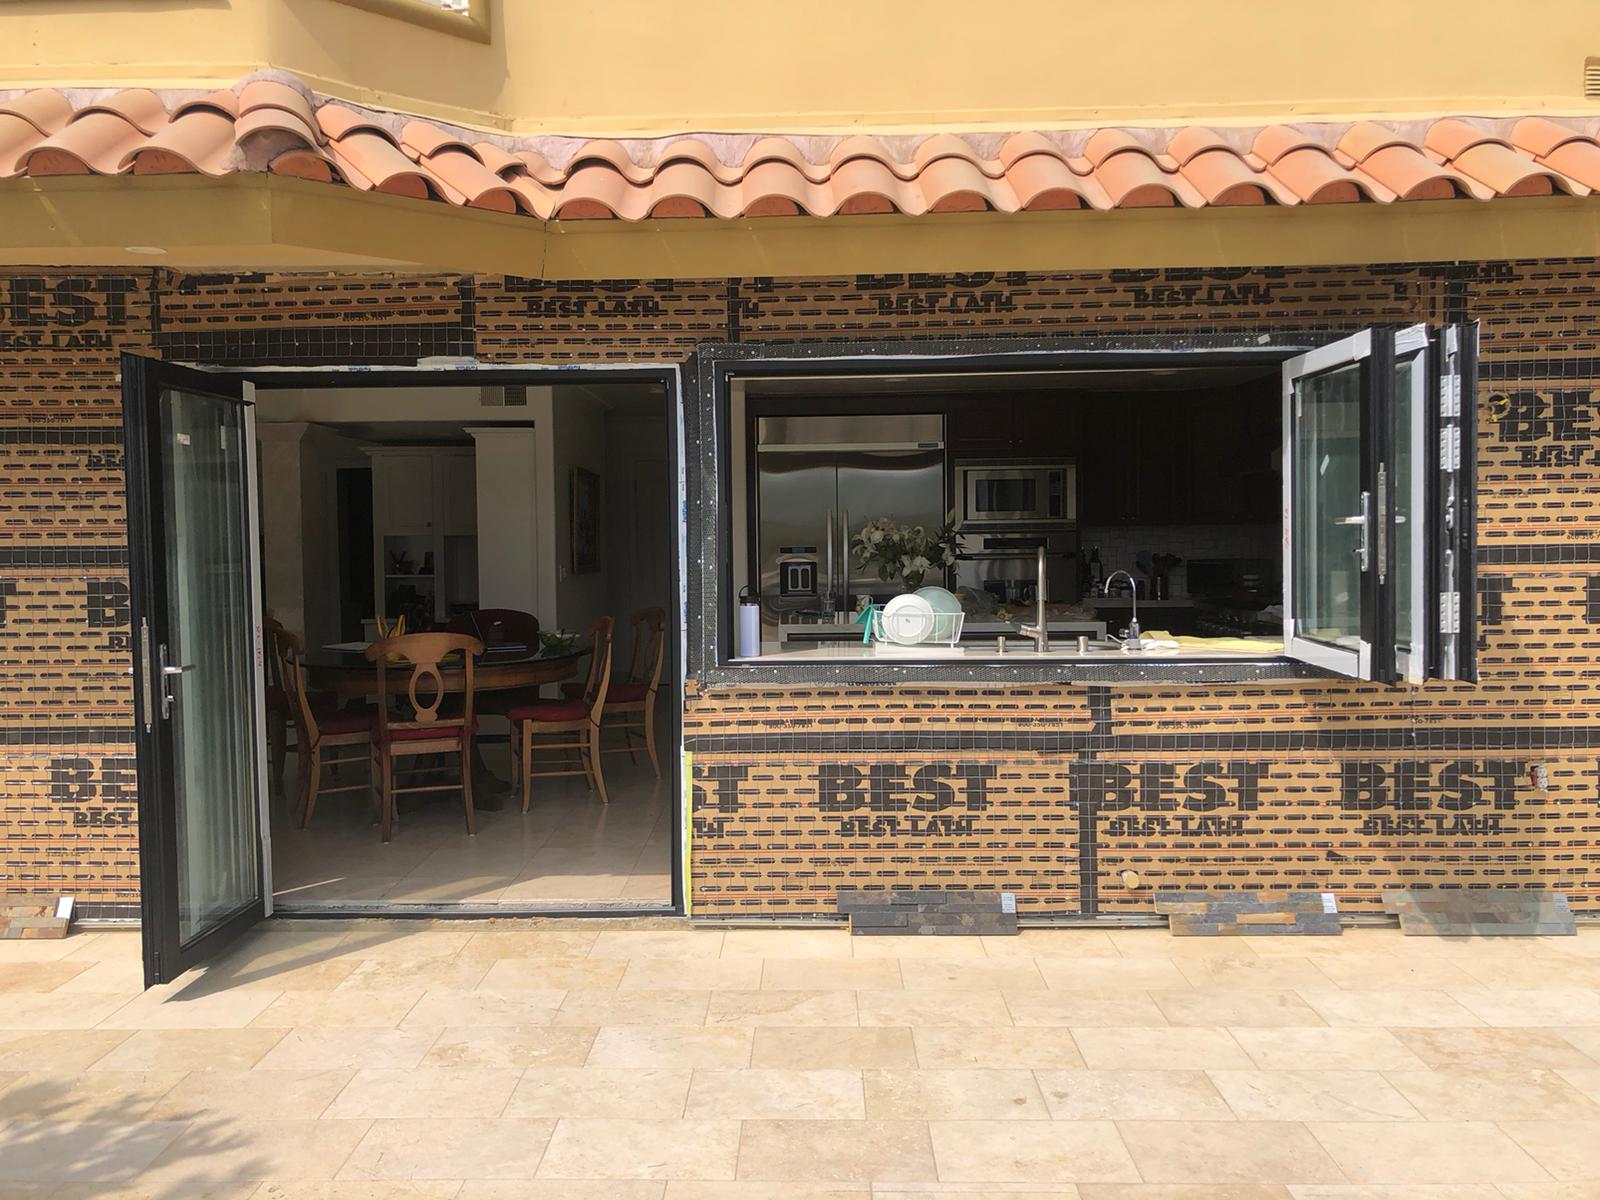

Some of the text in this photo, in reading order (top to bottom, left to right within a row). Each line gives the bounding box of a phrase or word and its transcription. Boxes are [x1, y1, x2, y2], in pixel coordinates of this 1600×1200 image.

[0, 278, 137, 327] EST
[878, 293, 1013, 316] BEST LATH
[1134, 285, 1271, 308] BEST LATH
[527, 300, 660, 318] BEST LATH
[0, 334, 113, 352] EST LATH
[1499, 391, 1600, 442] BE
[1521, 450, 1584, 468] BEST
[51, 758, 138, 804] BE
[819, 765, 998, 812] BEST
[1069, 763, 1269, 812] BEST
[1341, 761, 1526, 810] BEST
[74, 811, 131, 828] BEST
[841, 819, 973, 837] BEST LATH
[1109, 819, 1244, 837] BEST LATH
[1363, 818, 1501, 836] BEST LATH
